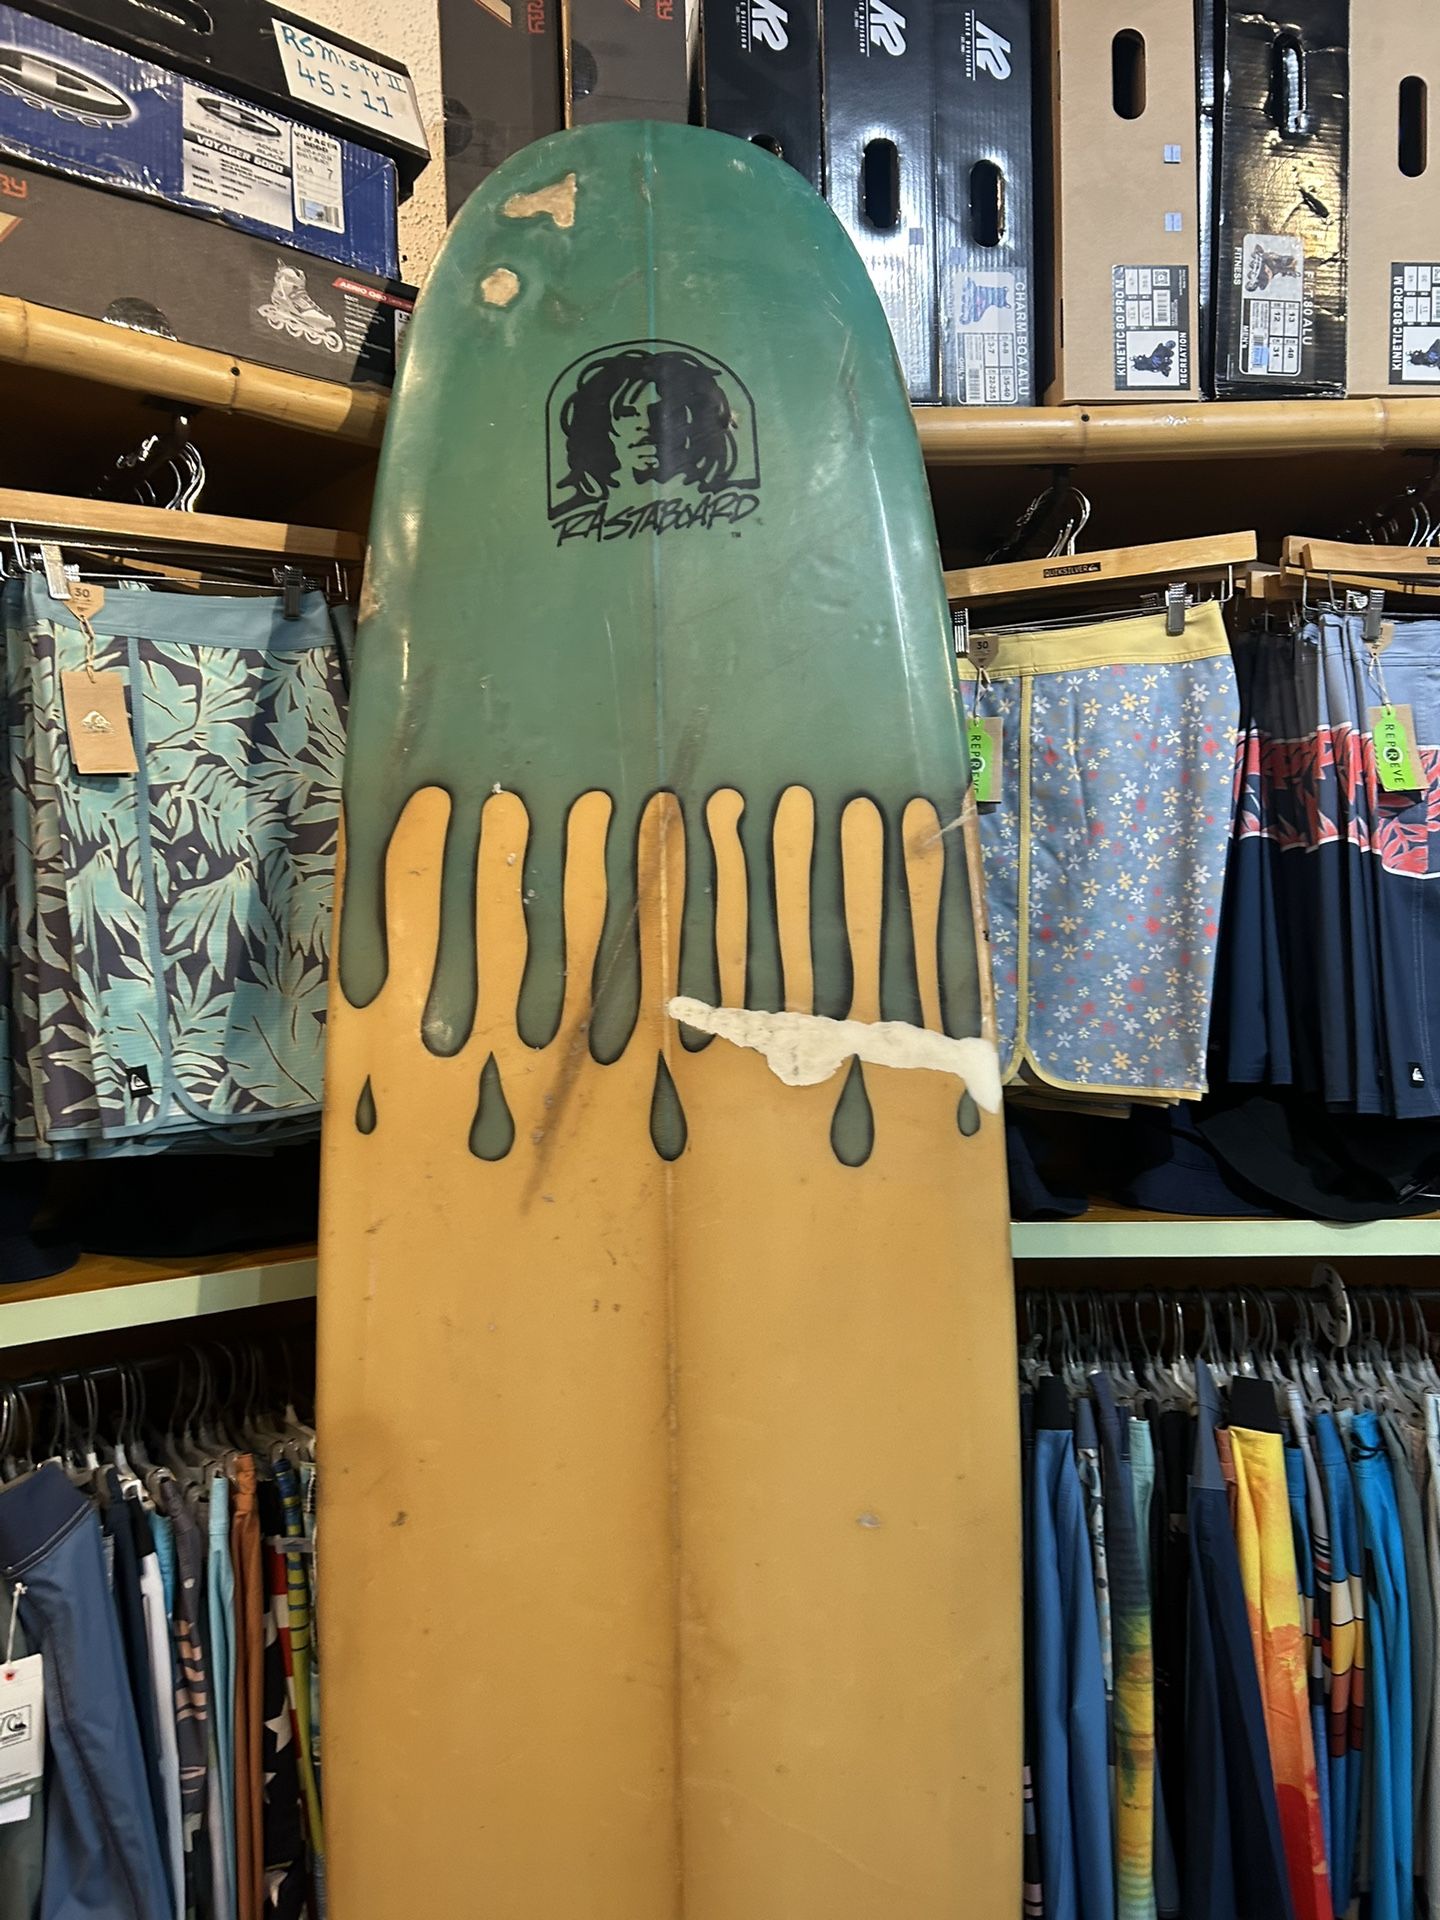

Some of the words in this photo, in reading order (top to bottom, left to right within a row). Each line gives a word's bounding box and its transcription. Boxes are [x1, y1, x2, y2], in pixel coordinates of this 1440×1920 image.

[752, 0, 789, 51] K2
[870, 0, 906, 56] K2
[976, 20, 1011, 80] K2
[196, 134, 252, 161] VOYAGER
[327, 168, 333, 180] 7
[1234, 247, 1242, 285] FITNESS
[1393, 276, 1403, 285] M
[1015, 281, 1026, 332] CHARM
[1115, 291, 1125, 313] PRO
[1393, 288, 1403, 309] PRO
[1115, 315, 1125, 329] 80
[1303, 318, 1313, 346] ALU
[1393, 311, 1402, 325] 80
[1116, 331, 1126, 376] KINETIC
[1179, 331, 1187, 384] RECREATION
[1392, 327, 1402, 371] KINETIC
[1018, 367, 1029, 396] ALU
[552, 493, 760, 547] RASTABOARD
[1044, 565, 1089, 577] QUIKSILVER
[74, 587, 90, 598] 30
[976, 640, 989, 650] 30
[1383, 723, 1406, 784] REPREVE
